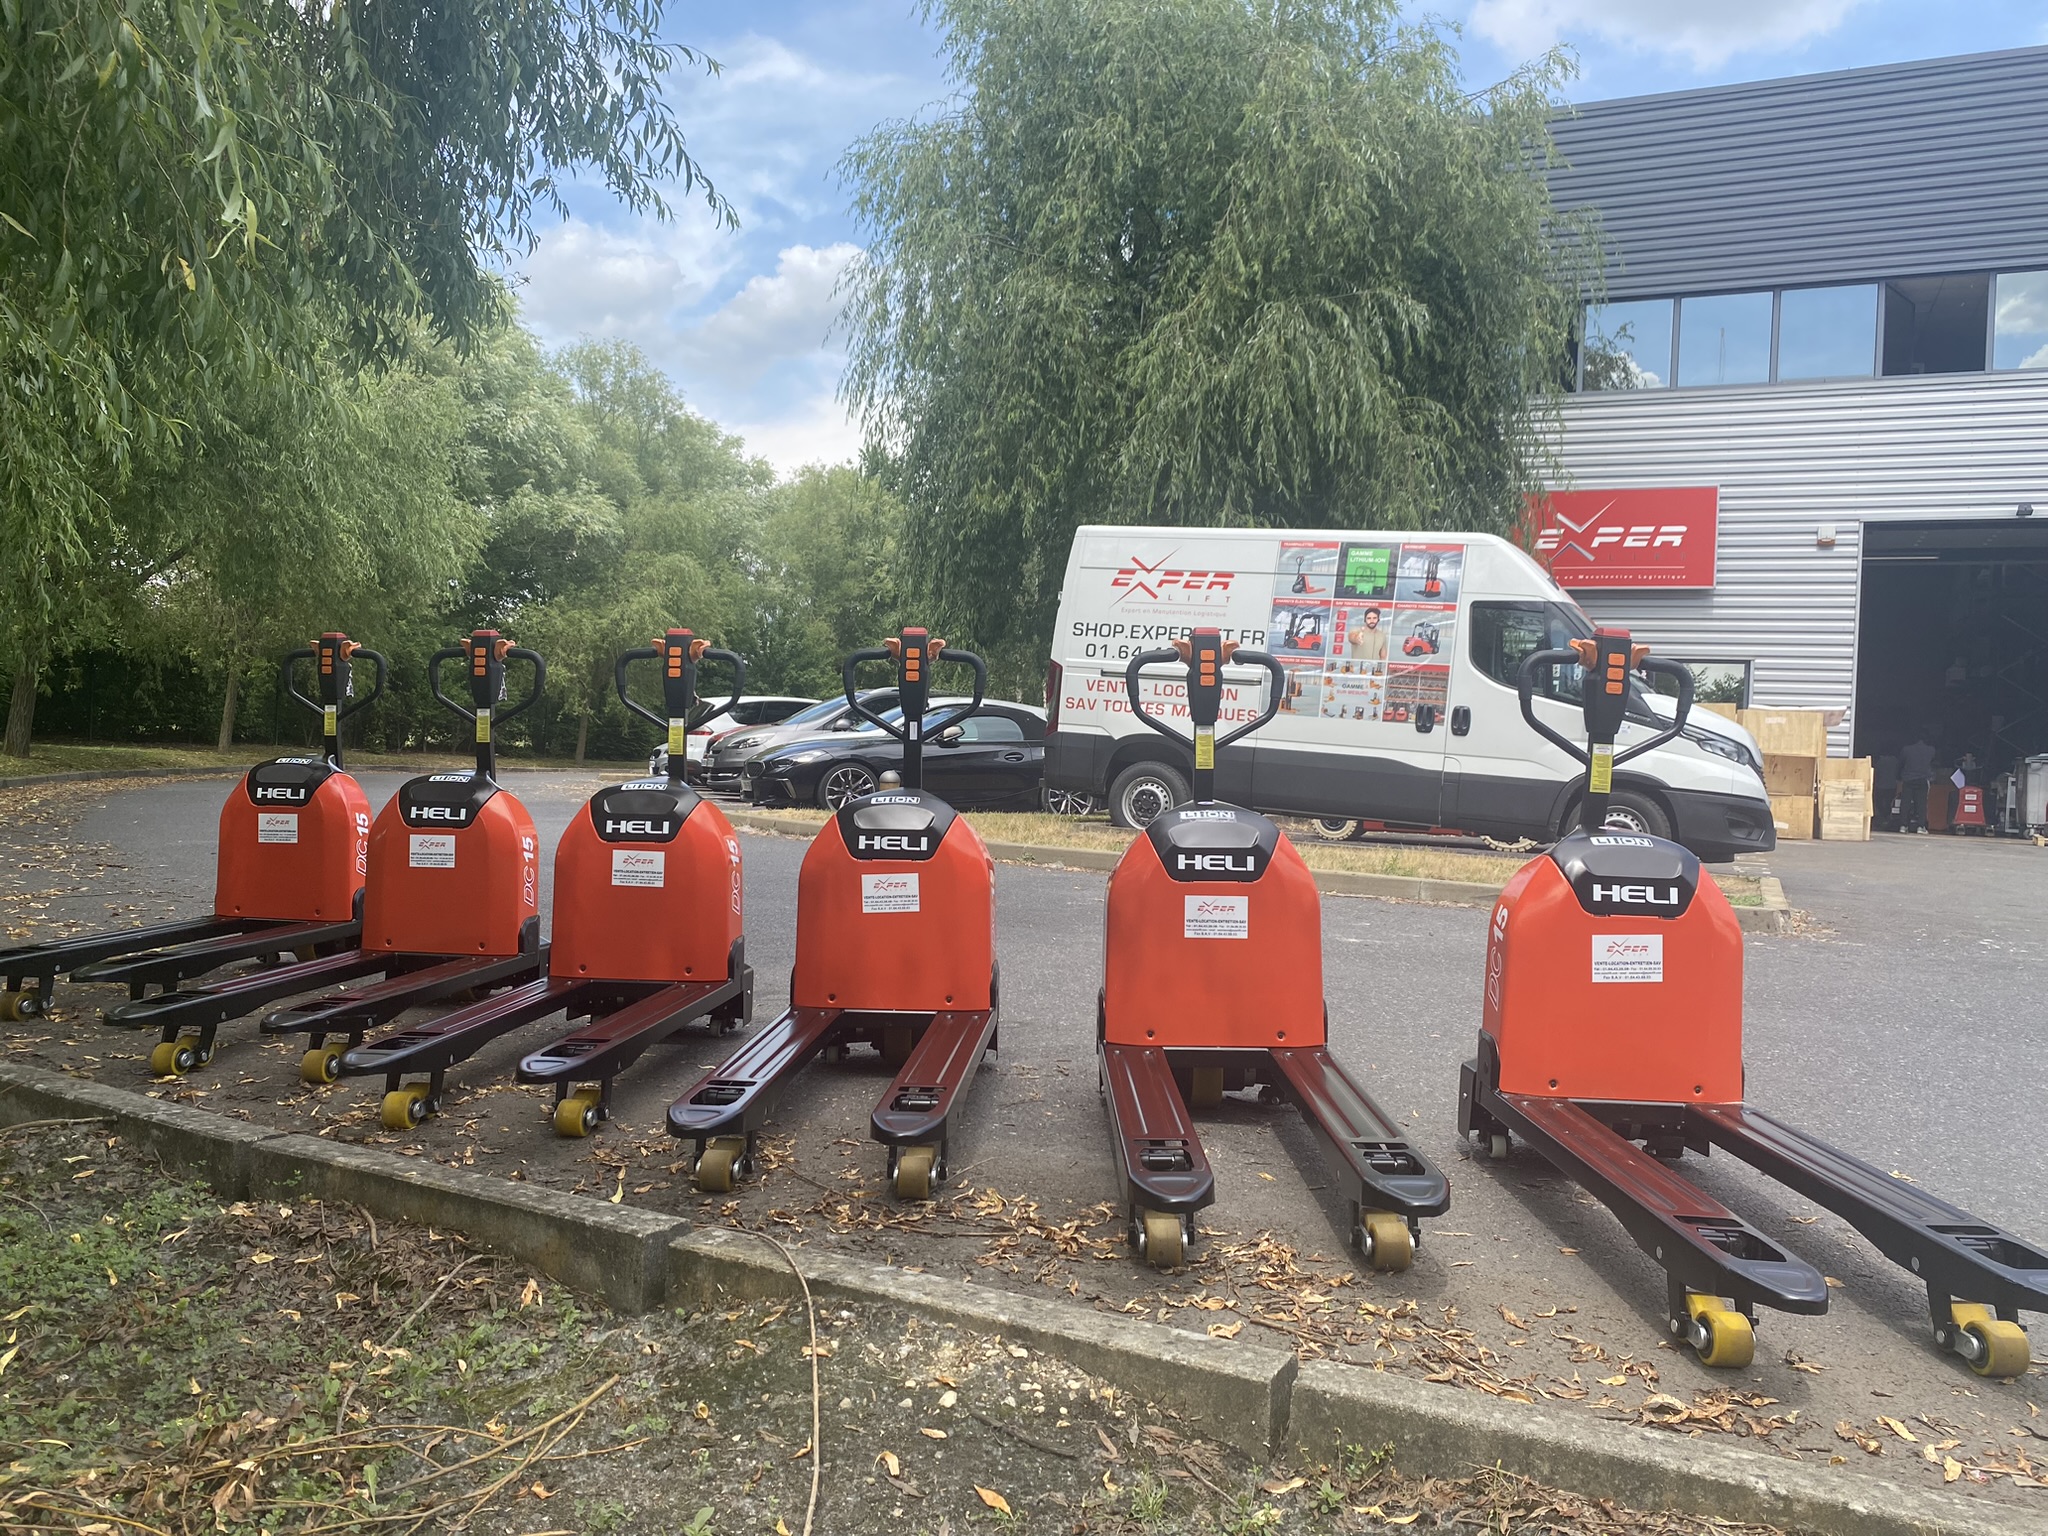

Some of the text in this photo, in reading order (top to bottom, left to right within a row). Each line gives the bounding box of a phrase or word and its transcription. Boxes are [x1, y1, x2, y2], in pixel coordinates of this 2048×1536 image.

[1534, 514, 1688, 561] EXPER
[1110, 557, 1235, 598] EXPER
[1167, 594, 1232, 604] LIFT
[1086, 679, 1127, 694] VENT
[1065, 697, 1097, 711] SAV
[257, 787, 305, 800] HELI
[410, 806, 466, 821] HELI
[355, 812, 369, 837] 15
[605, 820, 670, 835] HELI
[522, 836, 535, 862] 15
[858, 835, 928, 851] HELI
[726, 839, 740, 867] 15
[1177, 854, 1255, 871] HELI
[1592, 884, 1679, 905] HELI
[1494, 904, 1509, 942] 15
